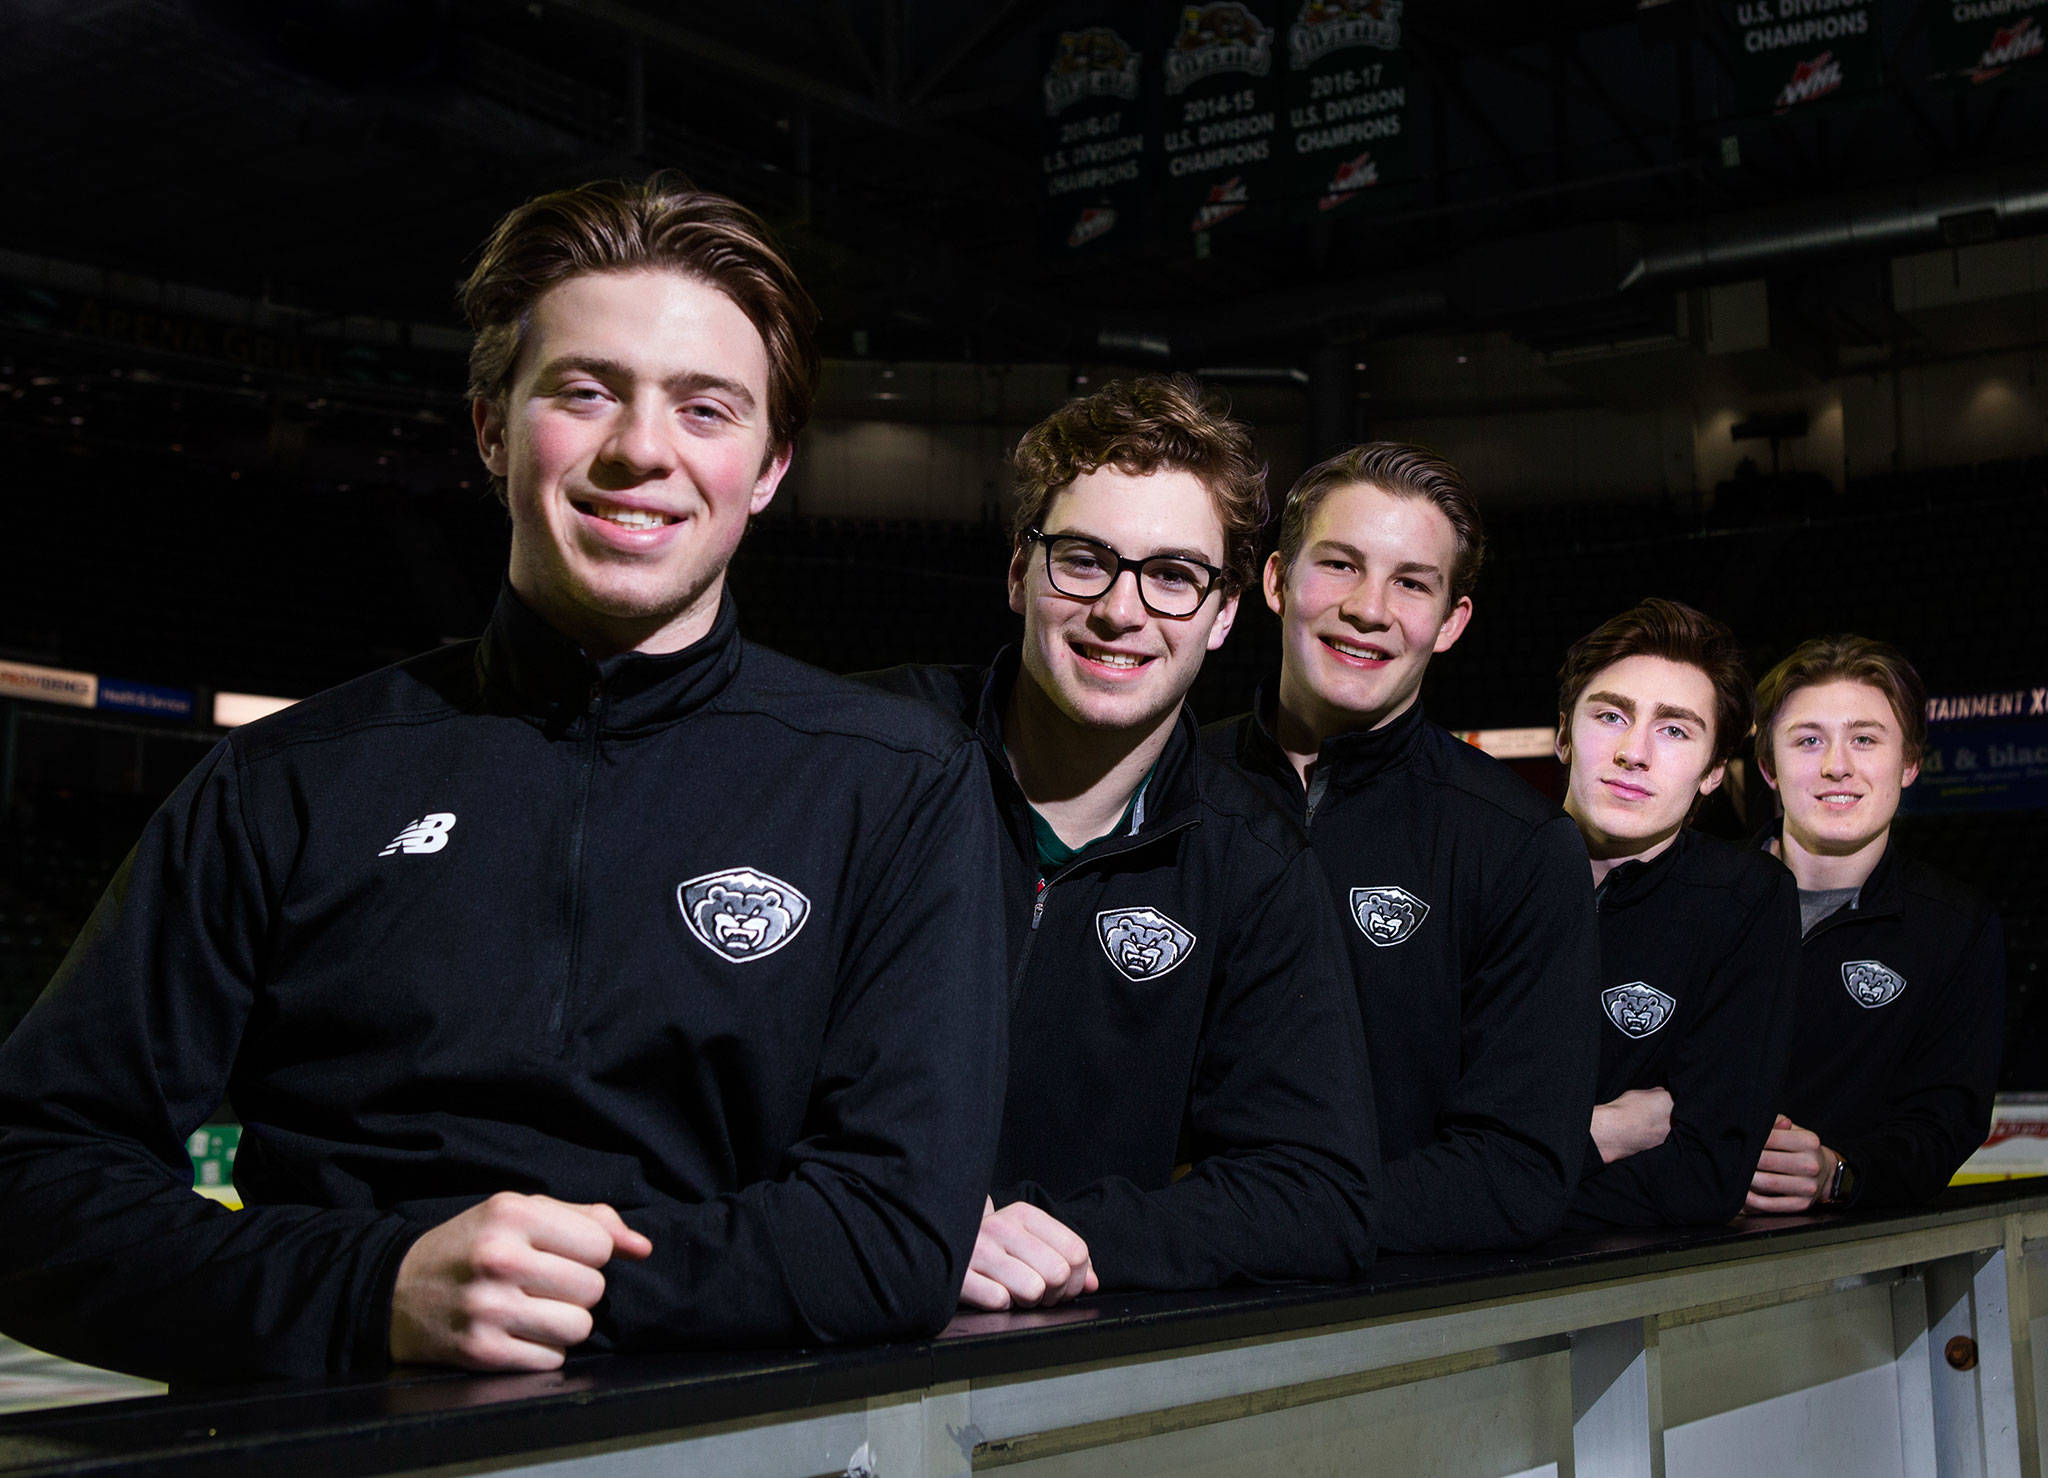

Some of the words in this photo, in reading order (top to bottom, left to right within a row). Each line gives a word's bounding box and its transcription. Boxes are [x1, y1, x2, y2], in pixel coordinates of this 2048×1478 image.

[1744, 10, 1868, 52] CHAMPIONS
[1310, 63, 1384, 99] 2016-17
[1183, 89, 1255, 123] 2014-15
[1290, 106, 1322, 128] U.S.
[1325, 87, 1406, 121] DIVISION
[1164, 129, 1195, 152] U.S.
[1197, 112, 1275, 146] DIVISION
[1295, 114, 1401, 153] CHAMPIONS
[1168, 139, 1271, 177] CHAMPIONS
[1925, 689, 2024, 722] TAINMENT
